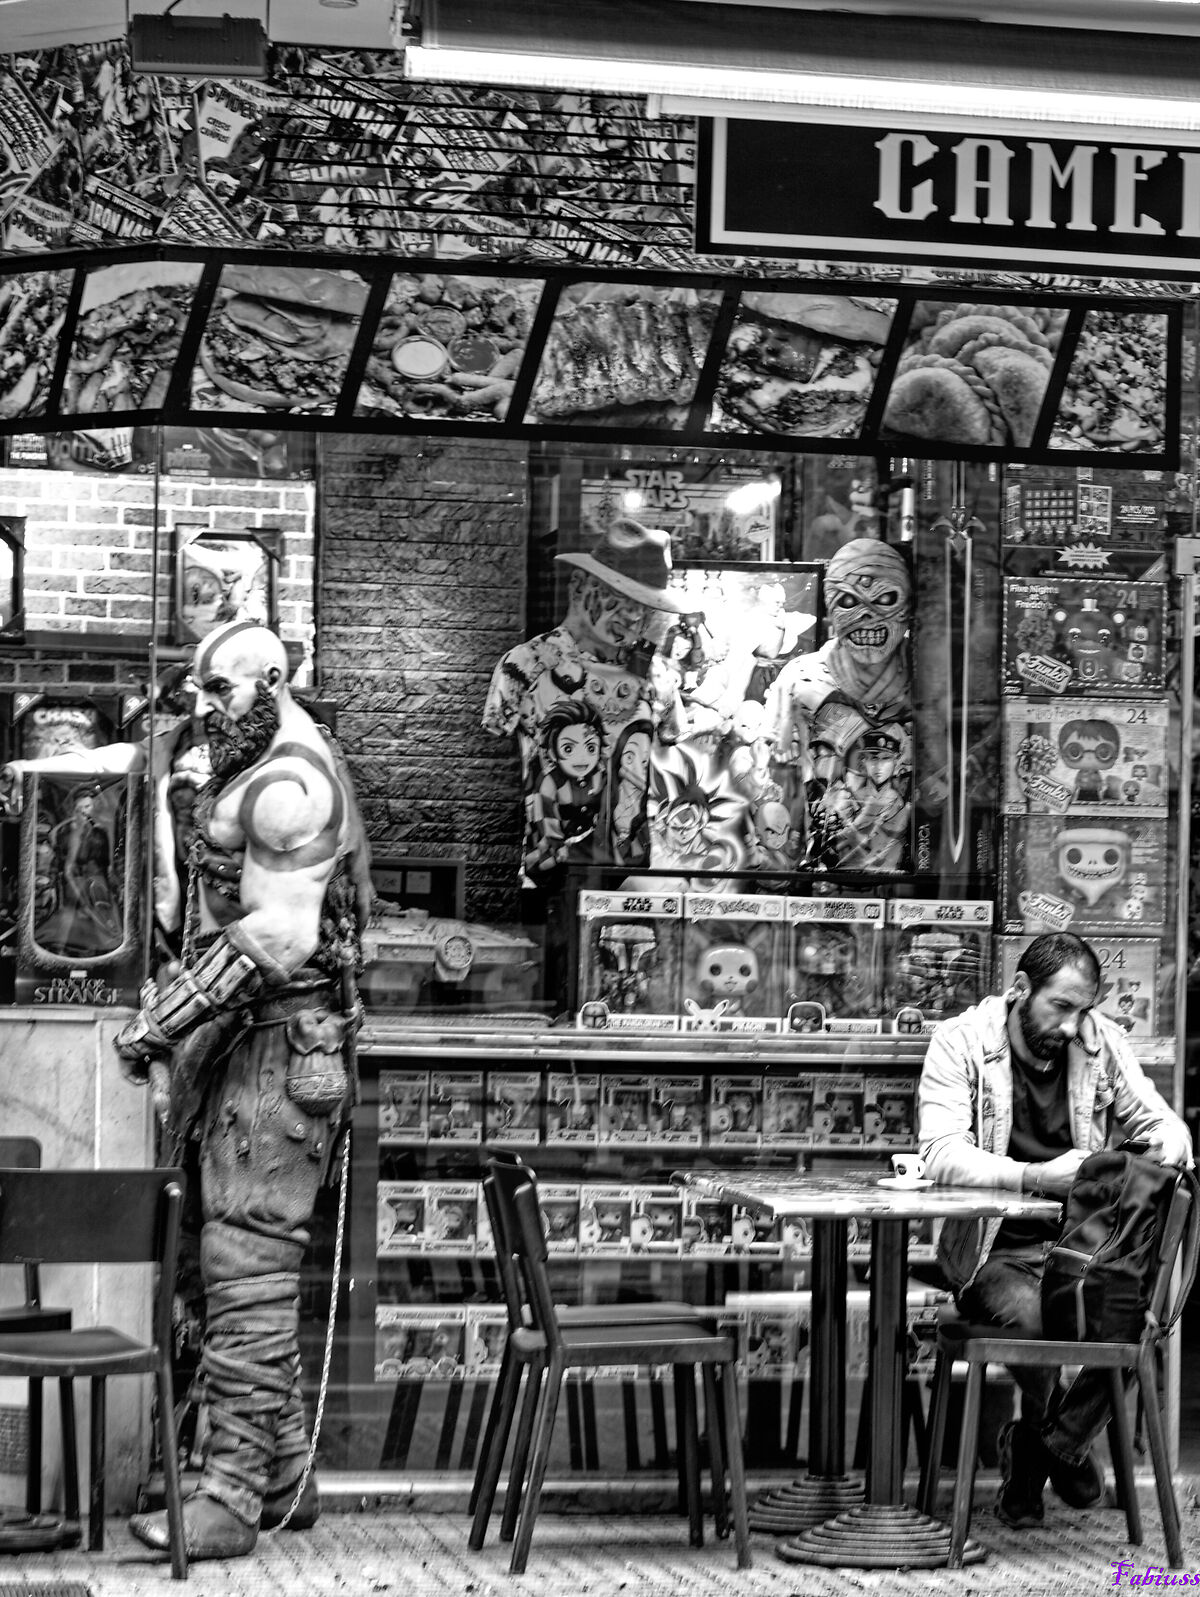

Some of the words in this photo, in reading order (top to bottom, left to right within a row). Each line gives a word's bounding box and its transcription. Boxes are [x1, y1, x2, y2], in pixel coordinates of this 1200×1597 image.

[625, 469, 684, 488] STAR
[621, 488, 691, 509] ARS
[1116, 589, 1138, 609] 24
[1027, 655, 1069, 682] Funko
[1126, 708, 1148, 724] 24
[1030, 774, 1072, 801] Funko
[1029, 894, 1072, 920] Funko
[1099, 948, 1127, 969] 24
[34, 986, 123, 1004] STRANGE
